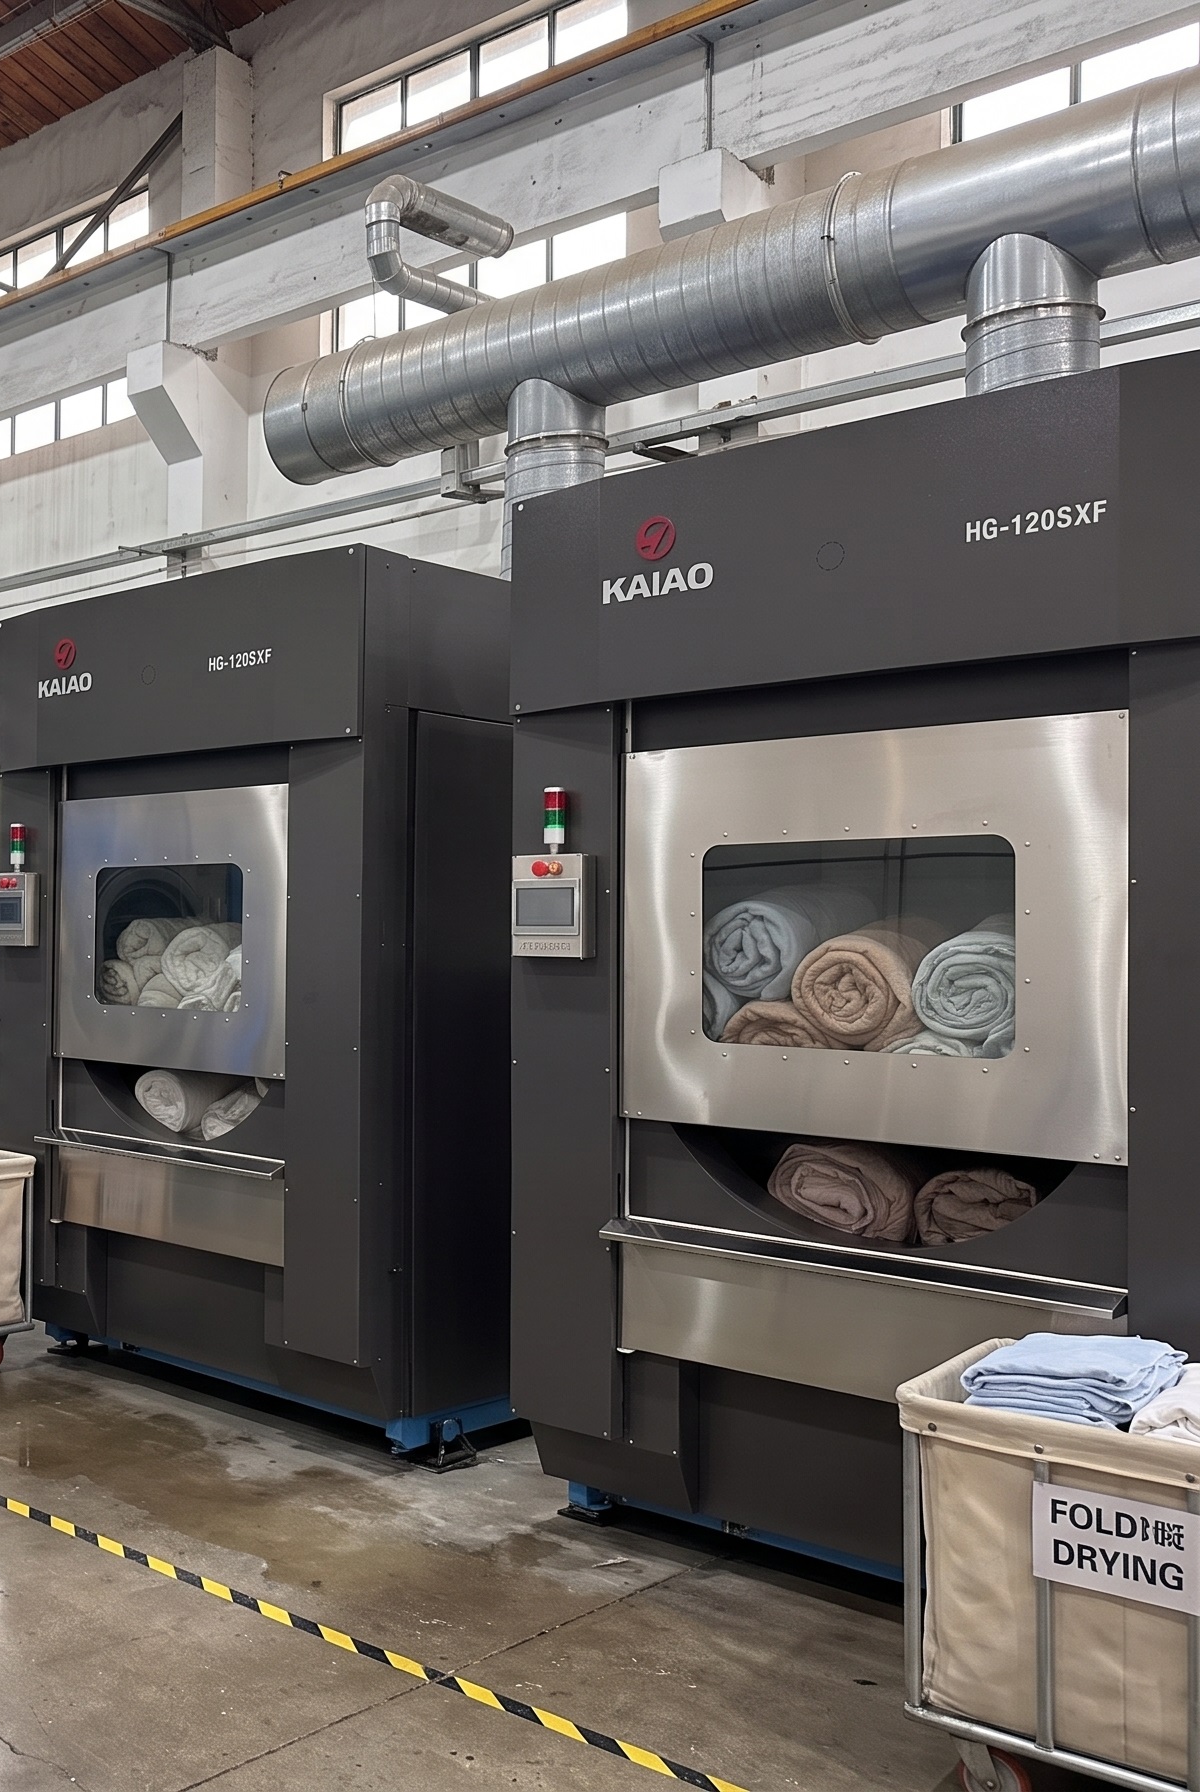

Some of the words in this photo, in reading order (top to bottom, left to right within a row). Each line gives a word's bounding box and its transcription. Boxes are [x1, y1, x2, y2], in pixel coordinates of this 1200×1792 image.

[965, 499, 1108, 543] HG-120SXF
[602, 562, 714, 605] KAIAO
[208, 648, 272, 672] HG-120SXF
[38, 672, 92, 699] KAIAO
[1052, 1538, 1184, 1592] DRYING
